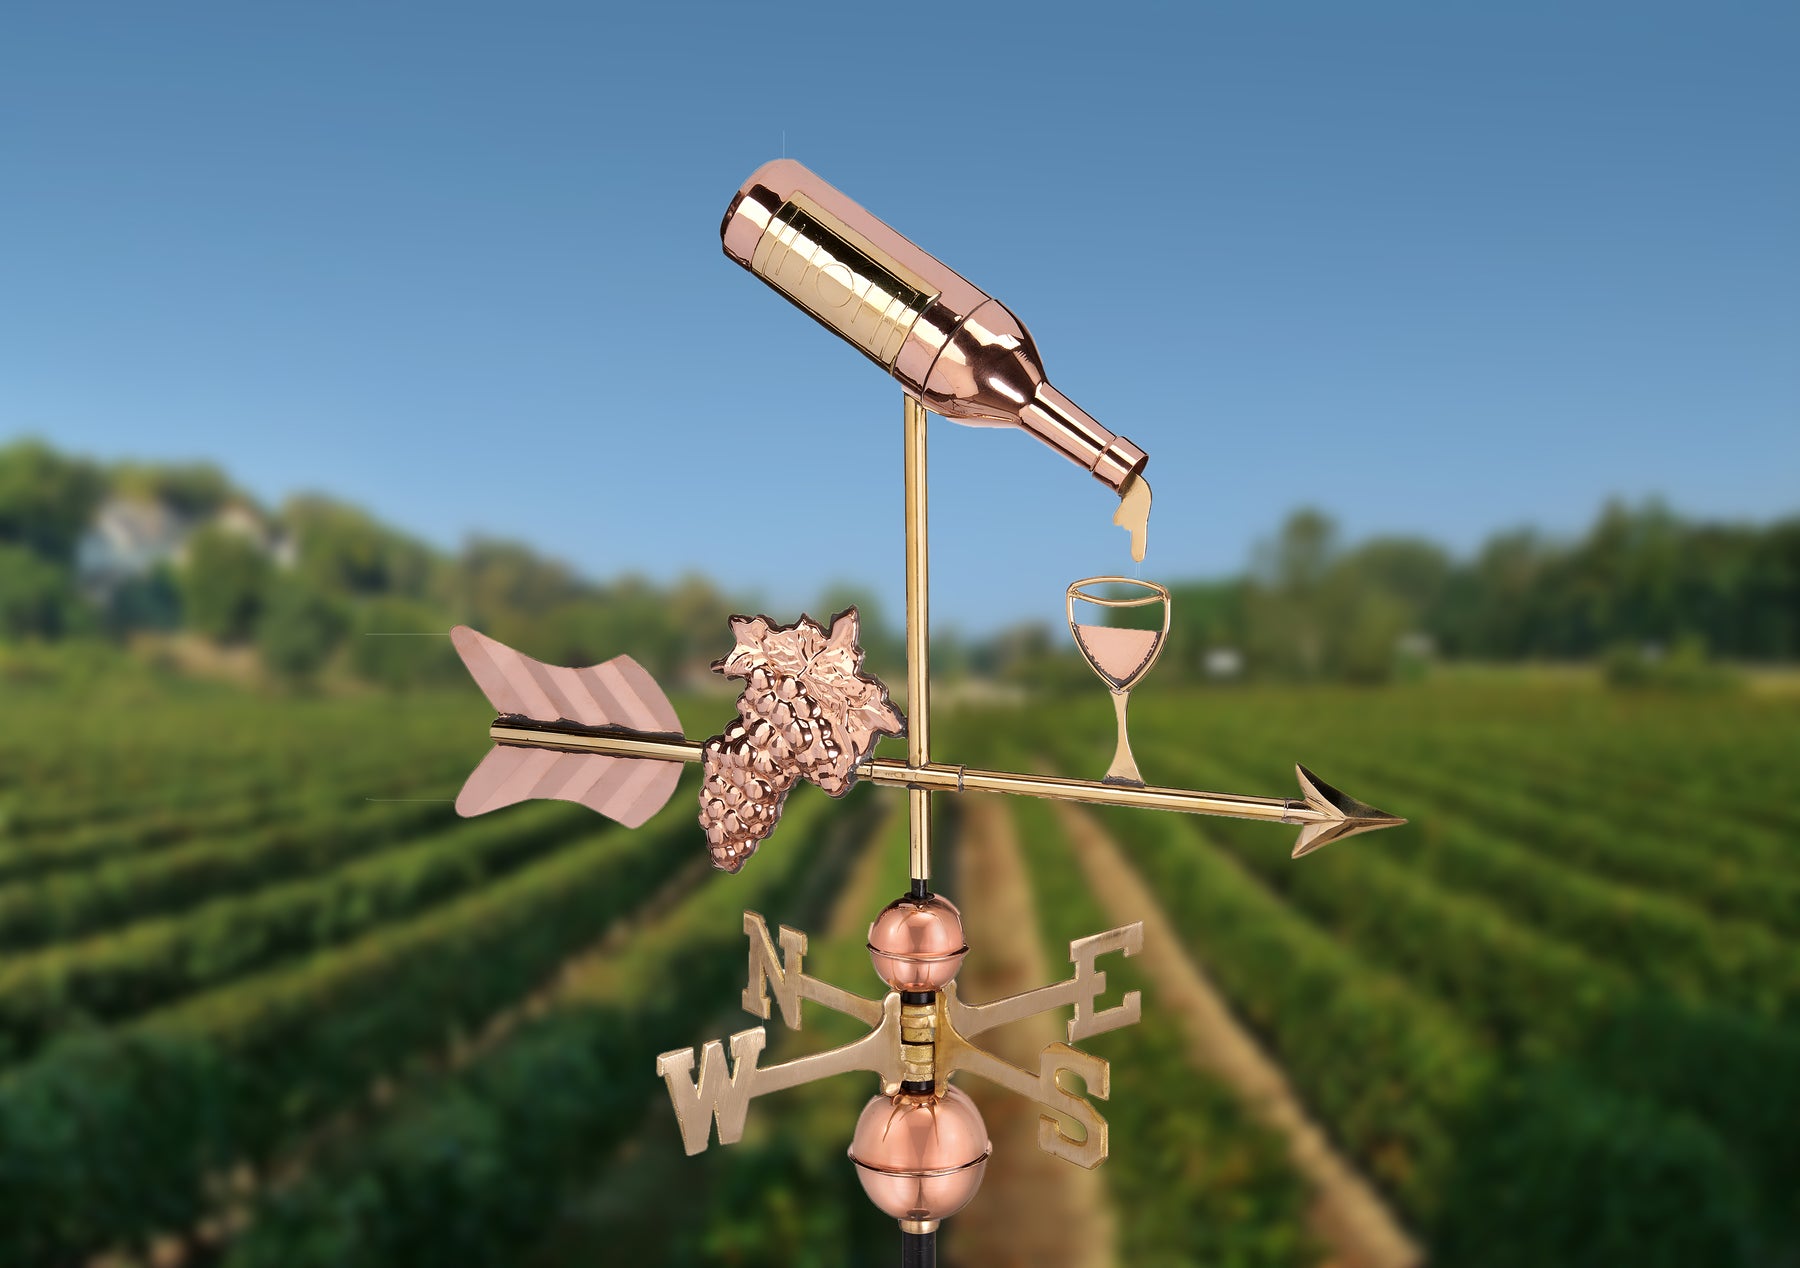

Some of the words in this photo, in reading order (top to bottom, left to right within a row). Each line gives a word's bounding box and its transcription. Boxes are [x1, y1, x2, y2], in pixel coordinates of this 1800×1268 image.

[742, 910, 808, 1031] N
[1067, 920, 1144, 1042] E
[656, 1026, 766, 1157] W
[1037, 1042, 1110, 1170] S
